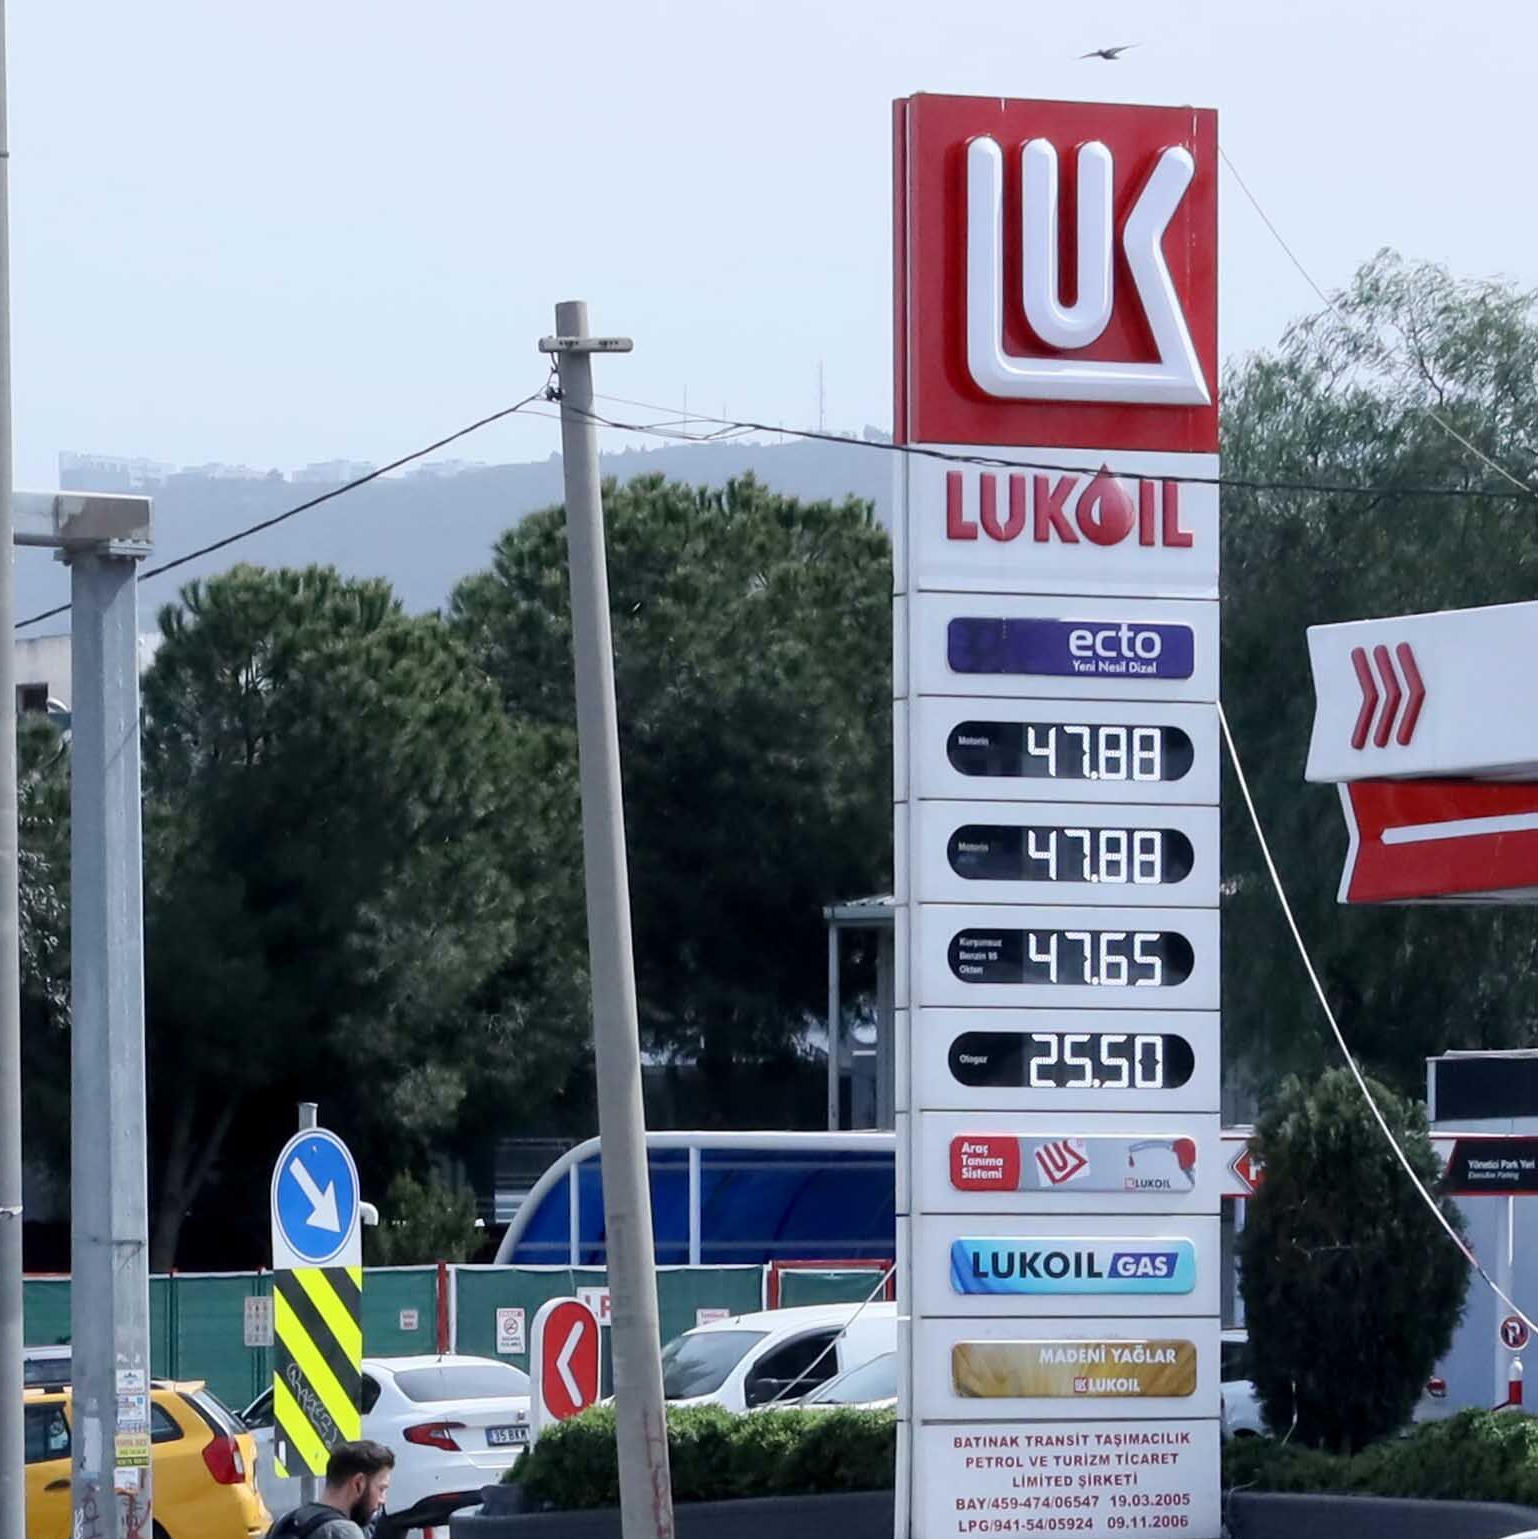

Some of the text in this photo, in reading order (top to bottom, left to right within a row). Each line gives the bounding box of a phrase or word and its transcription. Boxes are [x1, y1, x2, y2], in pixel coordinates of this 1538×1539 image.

[946, 462, 1193, 548] LUKOIL
[1069, 624, 1162, 659] ecto
[1072, 660, 1157, 674] Yeni Nesil Dizel
[1027, 725, 1162, 782] 47.88
[1027, 829, 1162, 885] 47.88
[1028, 931, 1163, 987] 47.65
[1029, 1033, 1164, 1089] 25.50
[961, 1141, 989, 1157] Araç
[961, 1154, 1004, 1166] Tanıma
[962, 1166, 1003, 1179] Sistemi
[972, 1251, 1168, 1279] LUKOIL GAS
[1038, 1345, 1177, 1364] MADENİ YAĞLAR
[1088, 1377, 1141, 1393] LUKOIL
[953, 1431, 1191, 1449] BATINAK TRANSİT TAŞIMACILIK
[965, 1451, 1180, 1469] PETROL VE TURİZM TİCARET
[1012, 1471, 1138, 1488] LİMİTED ŞİRKETİ
[1109, 1493, 1191, 1507] 19.03.2005
[1107, 1515, 1189, 1529] 09.11.2006
